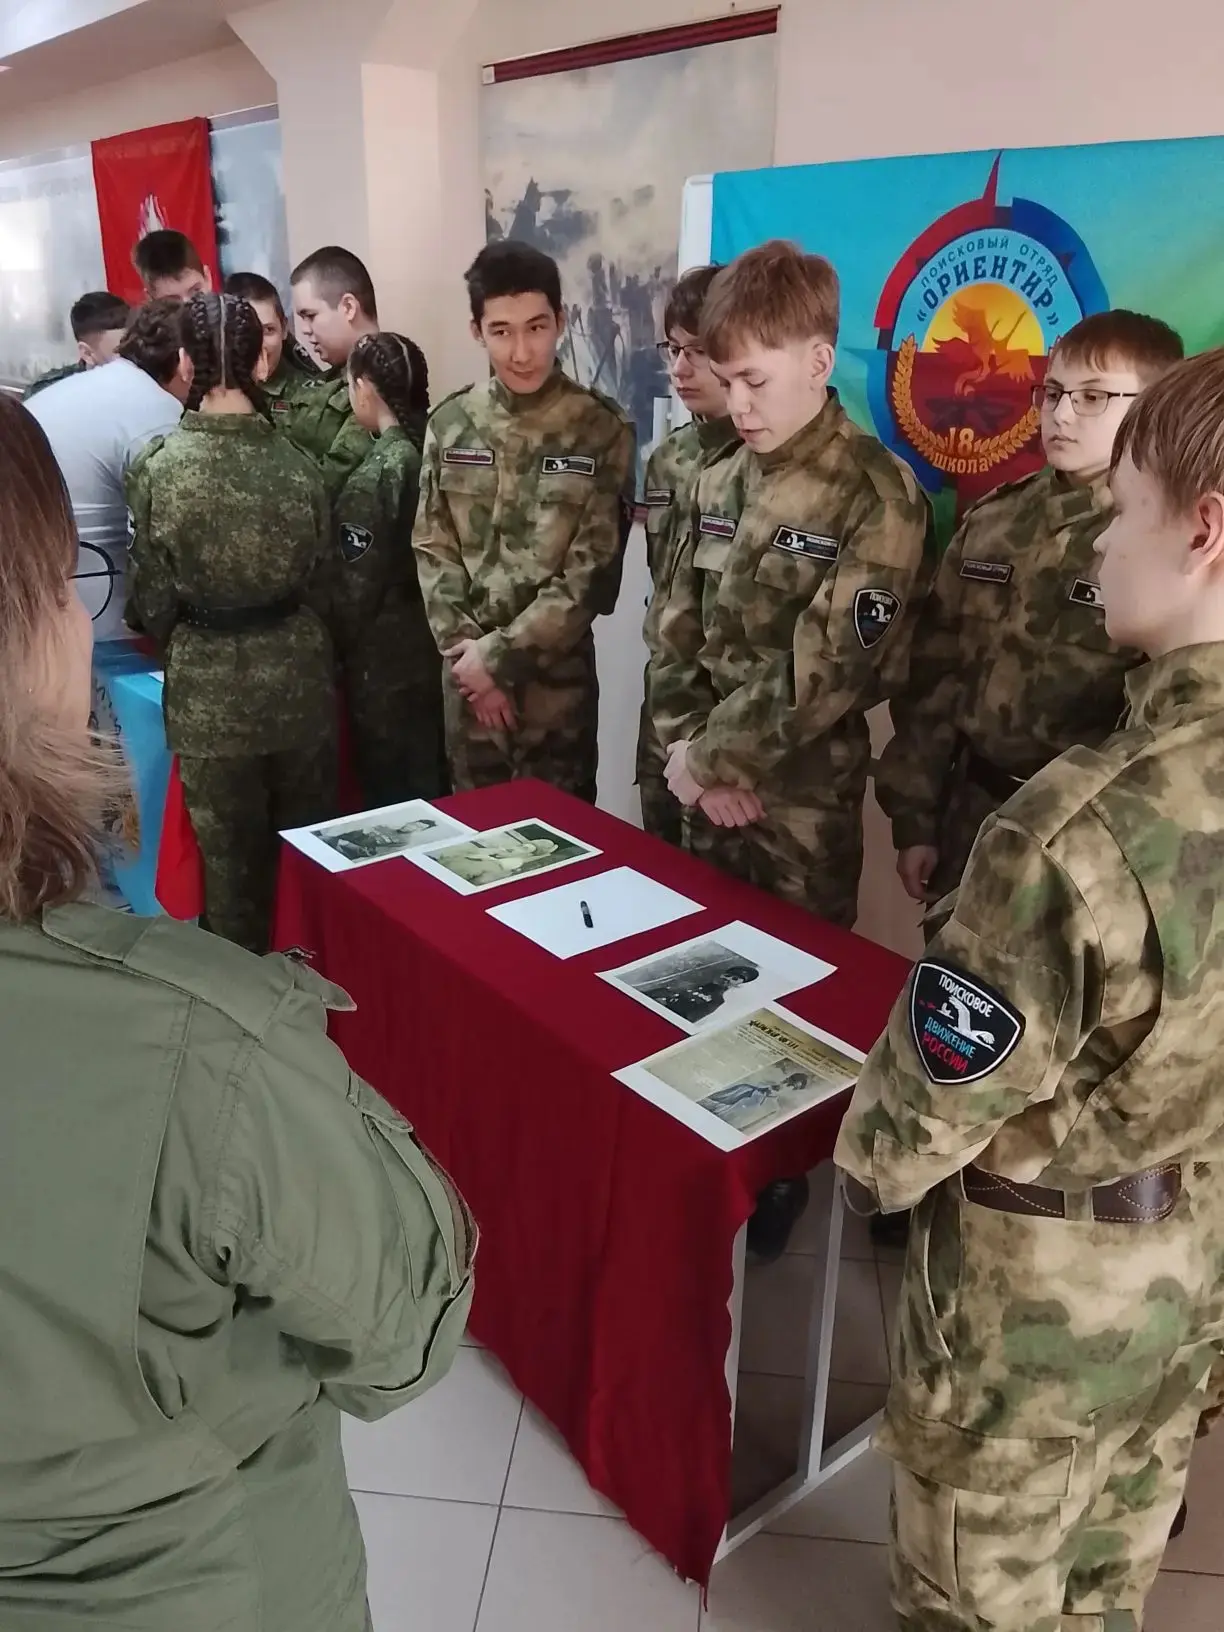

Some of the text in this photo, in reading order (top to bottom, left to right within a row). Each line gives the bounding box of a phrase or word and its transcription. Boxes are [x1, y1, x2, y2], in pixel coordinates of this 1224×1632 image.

[921, 236, 1058, 288] ПОИСКОВЫЙ ОТРЯД
[917, 255, 1059, 325] «ОРИЕНТИР»
[948, 427, 974, 456] 18
[938, 974, 994, 1017] ПОИСКОВОЕ
[921, 1032, 969, 1073] РОССИИ
[924, 1017, 976, 1059] ДВИЖЕНИЕ
